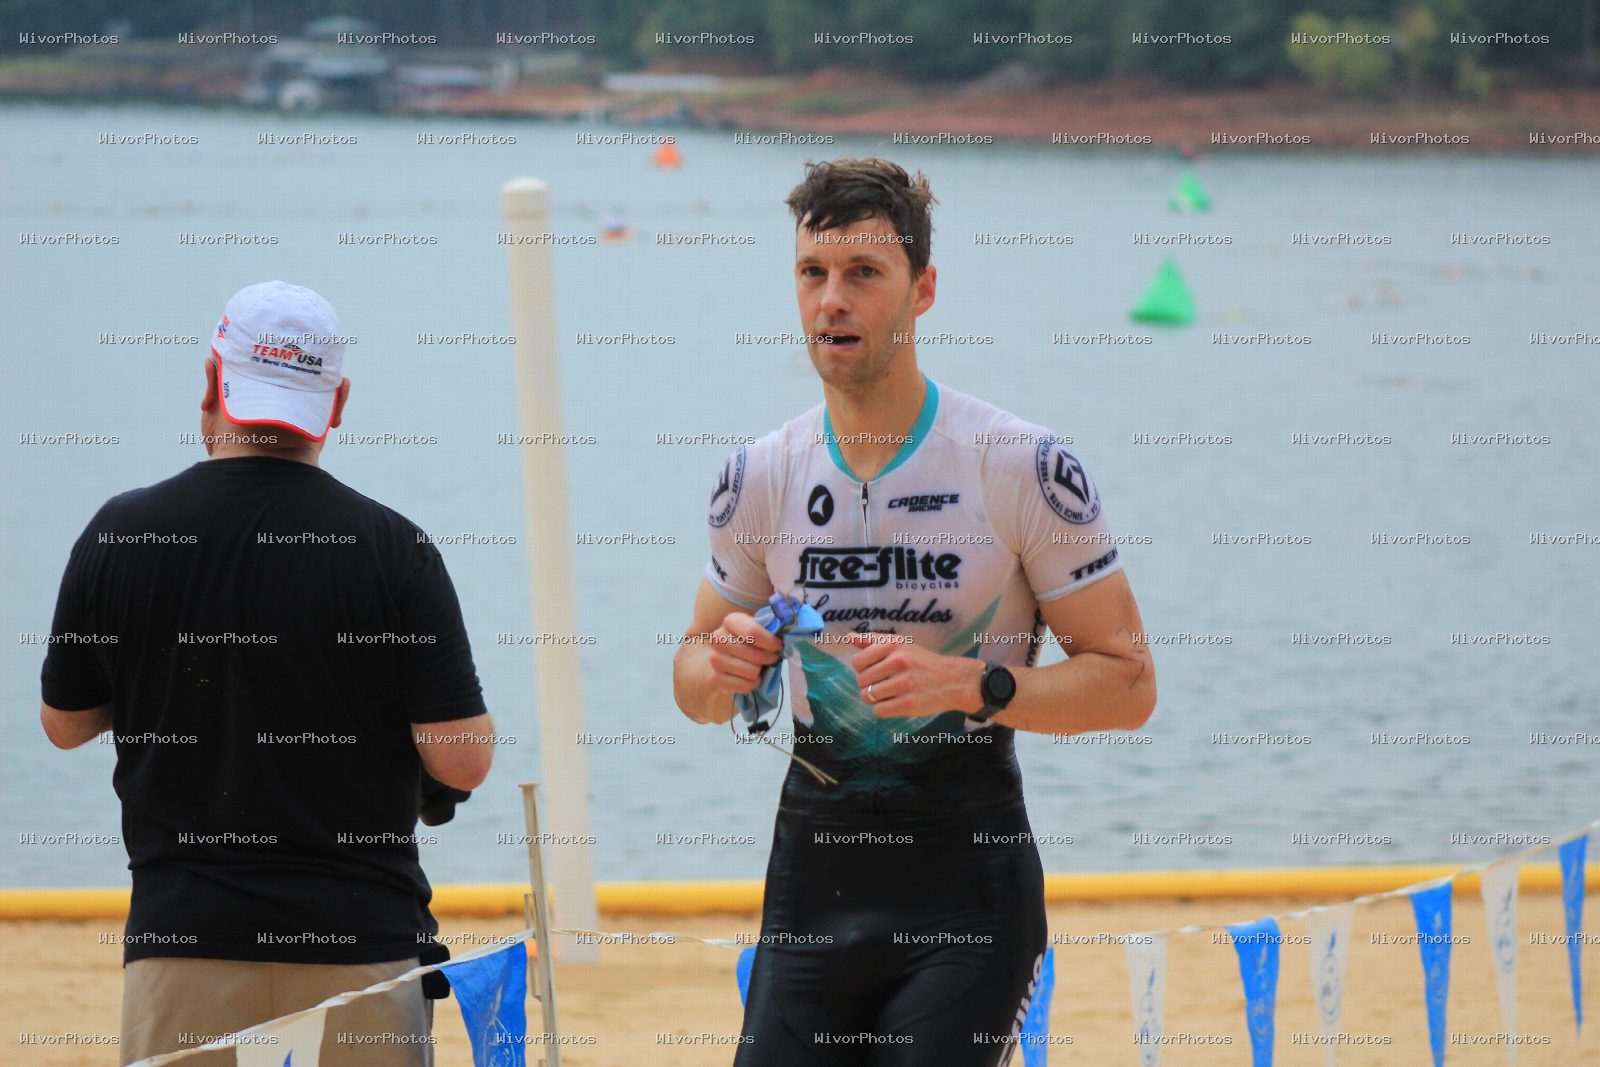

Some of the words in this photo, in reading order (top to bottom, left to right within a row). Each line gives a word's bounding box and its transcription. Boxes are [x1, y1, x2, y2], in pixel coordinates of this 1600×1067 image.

[252, 344, 293, 361] TEAM
[297, 354, 323, 367] USA
[888, 494, 960, 509] CADENCE
[908, 504, 942, 512] RACING
[1064, 507, 1083, 520] SINCE
[794, 546, 962, 588] free-flite
[895, 581, 959, 592] bicycles
